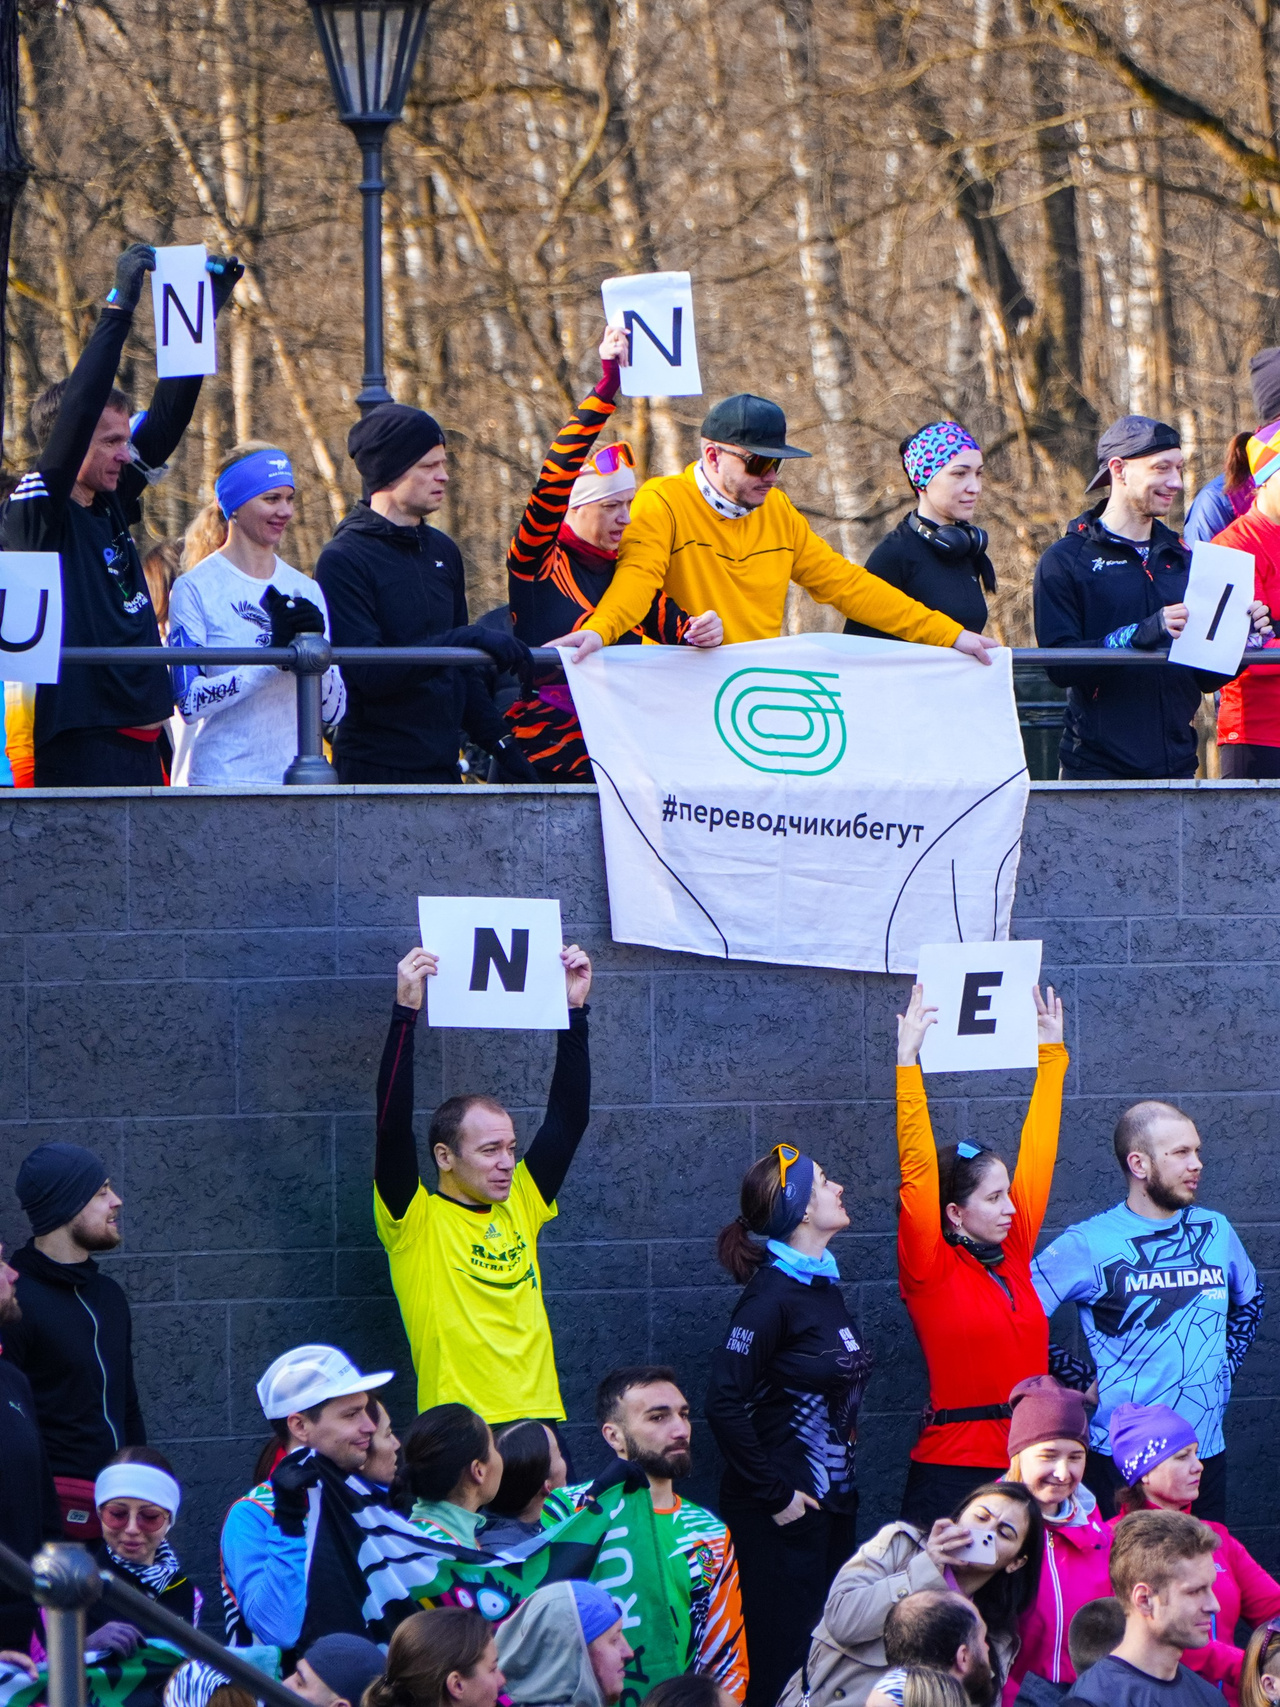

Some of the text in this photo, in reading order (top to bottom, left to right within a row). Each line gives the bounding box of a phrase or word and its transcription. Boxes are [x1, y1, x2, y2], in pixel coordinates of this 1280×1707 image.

[163, 281, 205, 347] N
[623, 307, 683, 367] N
[0, 588, 49, 653] U
[1205, 583, 1235, 641] I
[662, 794, 925, 849] #переводчикибегут
[469, 927, 530, 993] N
[957, 971, 1004, 1036] E
[471, 1257, 504, 1271] ULTRA
[1124, 1268, 1225, 1294] MALIDAK
[731, 1326, 755, 1344] NENA
